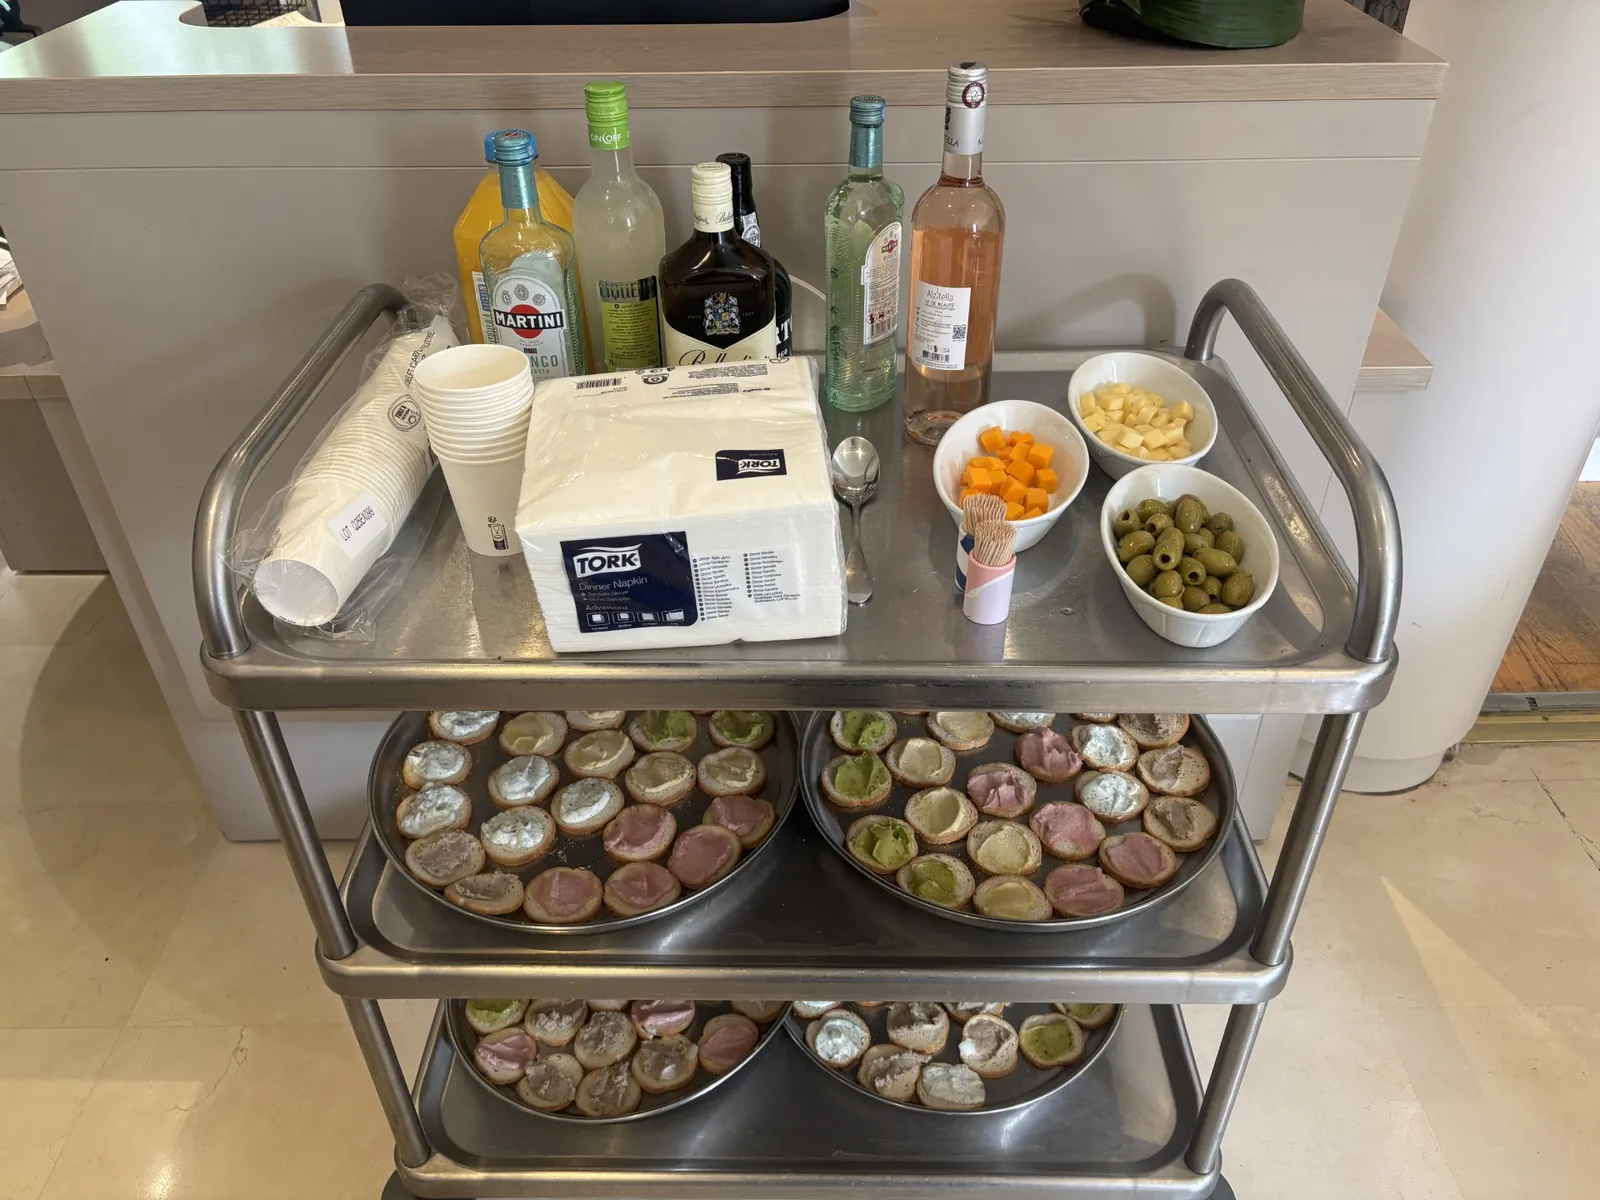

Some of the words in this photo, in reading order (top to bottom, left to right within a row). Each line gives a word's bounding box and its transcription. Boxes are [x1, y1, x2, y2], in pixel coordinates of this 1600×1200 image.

[495, 311, 561, 328] MARTINI
[531, 354, 559, 368] NCO
[740, 460, 778, 469] TORK
[340, 525, 352, 541] LOT
[576, 553, 637, 574] TORK
[579, 582, 610, 591] Dinner
[613, 576, 648, 589] Napkin
